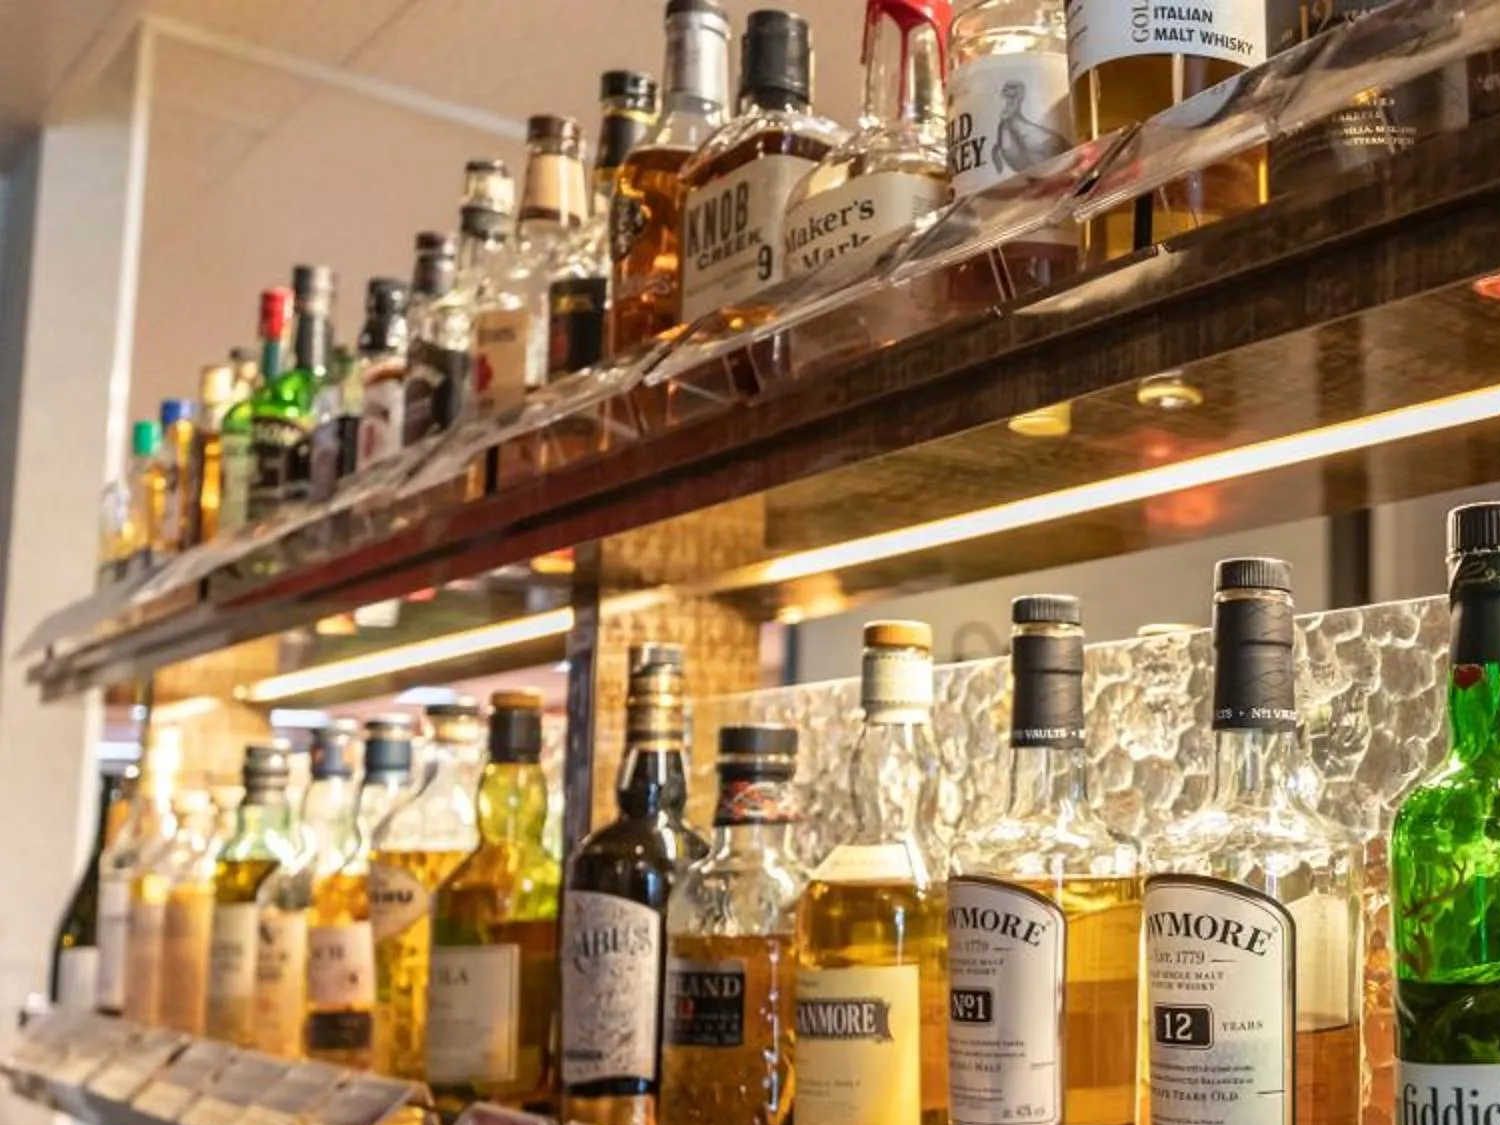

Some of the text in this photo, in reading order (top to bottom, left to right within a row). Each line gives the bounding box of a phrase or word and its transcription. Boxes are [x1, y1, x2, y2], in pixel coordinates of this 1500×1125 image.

[1153, 6, 1213, 24] ITALIAN
[1153, 29, 1253, 56] MALT WHISKY
[686, 181, 749, 257] KNOB
[757, 246, 774, 281] 9
[1164, 1011, 1263, 1041] 12 YEARS
